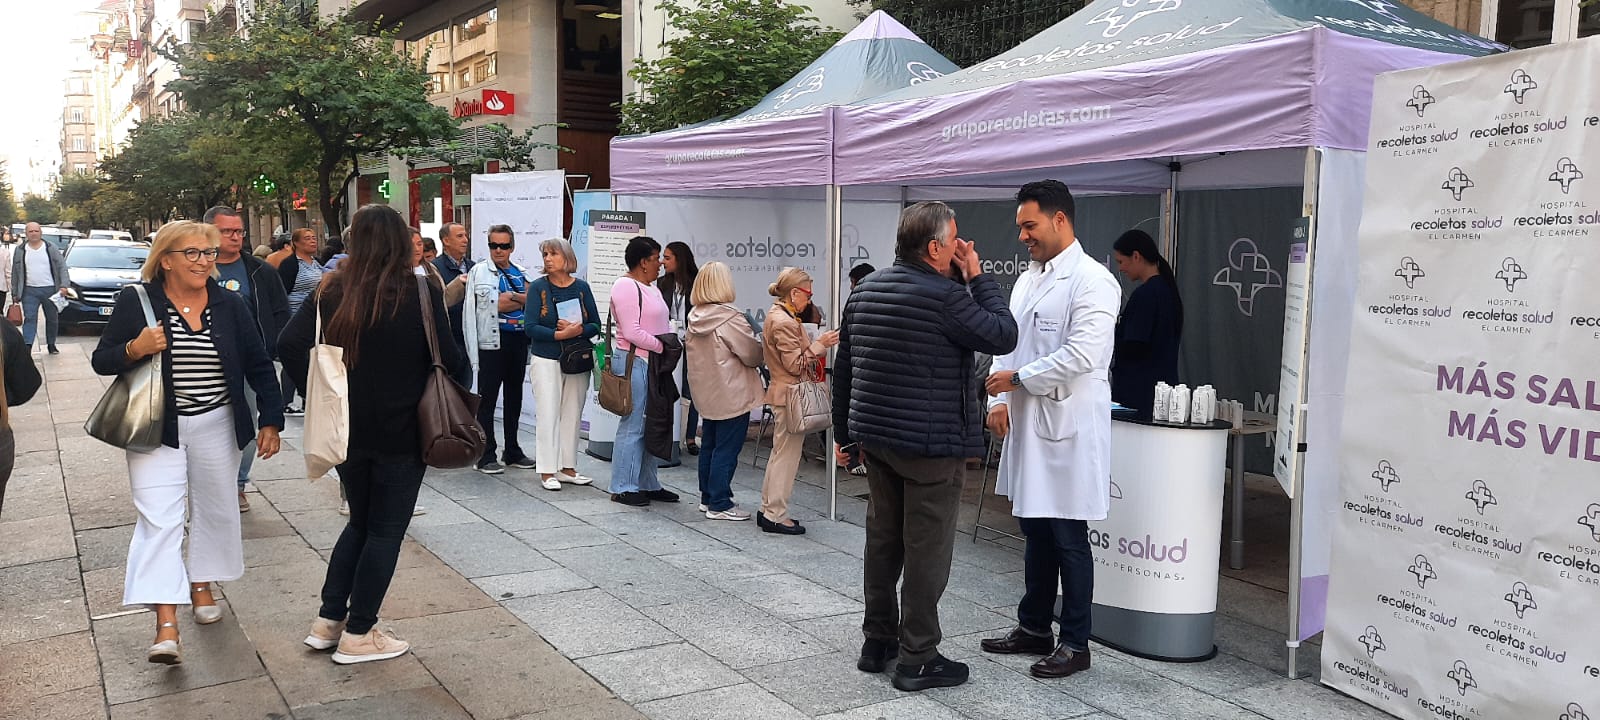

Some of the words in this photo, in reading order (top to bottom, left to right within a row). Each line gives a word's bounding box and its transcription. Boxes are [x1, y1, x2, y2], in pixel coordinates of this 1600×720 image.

[967, 40, 1121, 74] recoletas
[1126, 16, 1243, 49] salud
[942, 104, 1112, 142] gruporecoletas.com
[1470, 121, 1529, 139] recoletas
[1534, 116, 1568, 133] salud
[1377, 133, 1427, 148] recoletas
[1430, 128, 1458, 143] salud
[602, 214, 628, 222] PARADA
[1514, 212, 1572, 226] recoletas
[1541, 201, 1587, 210] HOSPITAL
[1410, 214, 1466, 231] recoletas
[1471, 216, 1503, 229] salud
[1368, 304, 1418, 316] recoletas
[1423, 306, 1451, 318] salud
[1462, 308, 1518, 322] recoletas
[1522, 310, 1553, 324] salud
[1437, 361, 1516, 400] MÁS
[1448, 408, 1526, 448] MÁS
[1343, 500, 1391, 520] recoletas
[1395, 508, 1423, 528] salud
[1118, 534, 1187, 563] salud
[1435, 523, 1488, 544] recoletas
[1492, 533, 1522, 554] salud
[1538, 552, 1600, 574] recoleta
[1377, 592, 1426, 618] recoletas
[1429, 610, 1458, 628] salud
[1468, 622, 1525, 651] recoletas
[1529, 641, 1566, 663] salud
[1334, 660, 1380, 686] recoletas
[1383, 677, 1409, 698] salud
